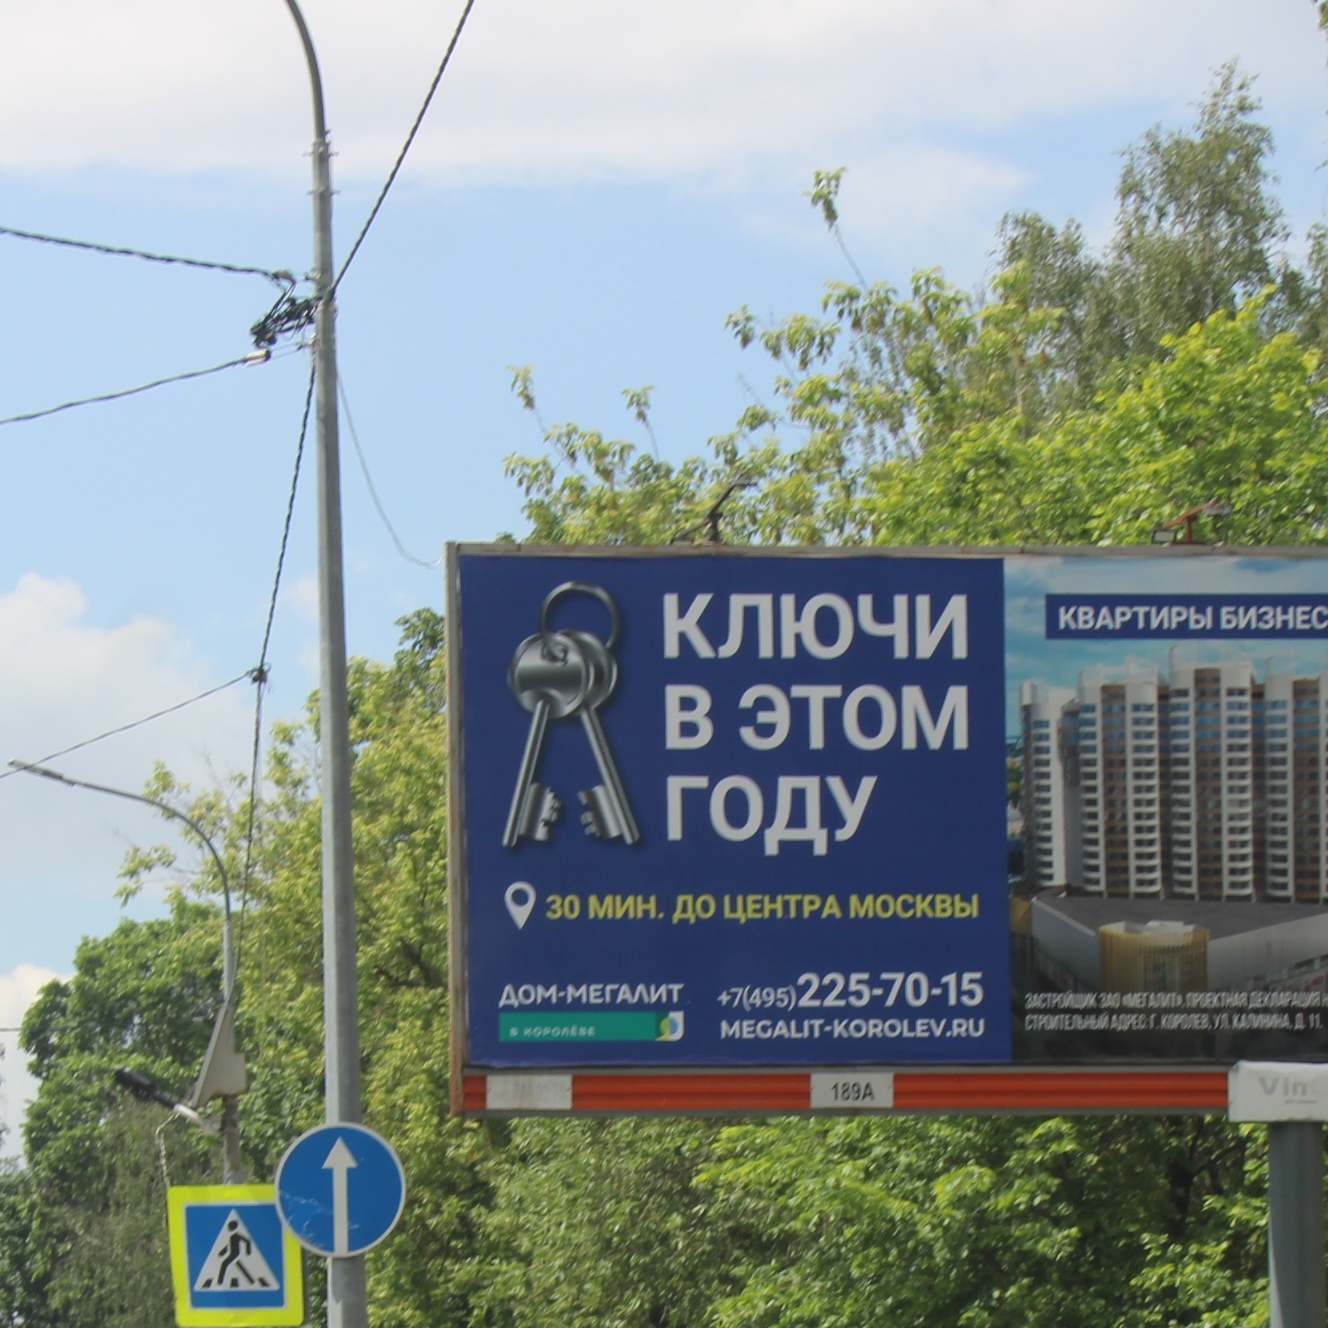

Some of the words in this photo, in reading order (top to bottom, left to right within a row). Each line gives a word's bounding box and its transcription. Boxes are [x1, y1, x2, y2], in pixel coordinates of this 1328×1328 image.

[663, 593, 969, 660] КЛЮЧИ
[1058, 606, 1213, 630] КВАРТИРЫ
[664, 685, 714, 751] В
[738, 684, 969, 751] ЭТОМ
[666, 775, 877, 856] ГОДУ
[546, 895, 580, 919] 30
[588, 895, 665, 919] МИН.
[672, 895, 715, 924] ДО
[723, 894, 842, 924] ЦЕНТРА
[848, 893, 980, 920] МОСКВЫ
[498, 983, 685, 1008] ДОМ-МЕГАЛИТ
[716, 972, 985, 1012] +7(495)225-70-15
[720, 1019, 985, 1040] MEGALIT-KOROLEV.RU
